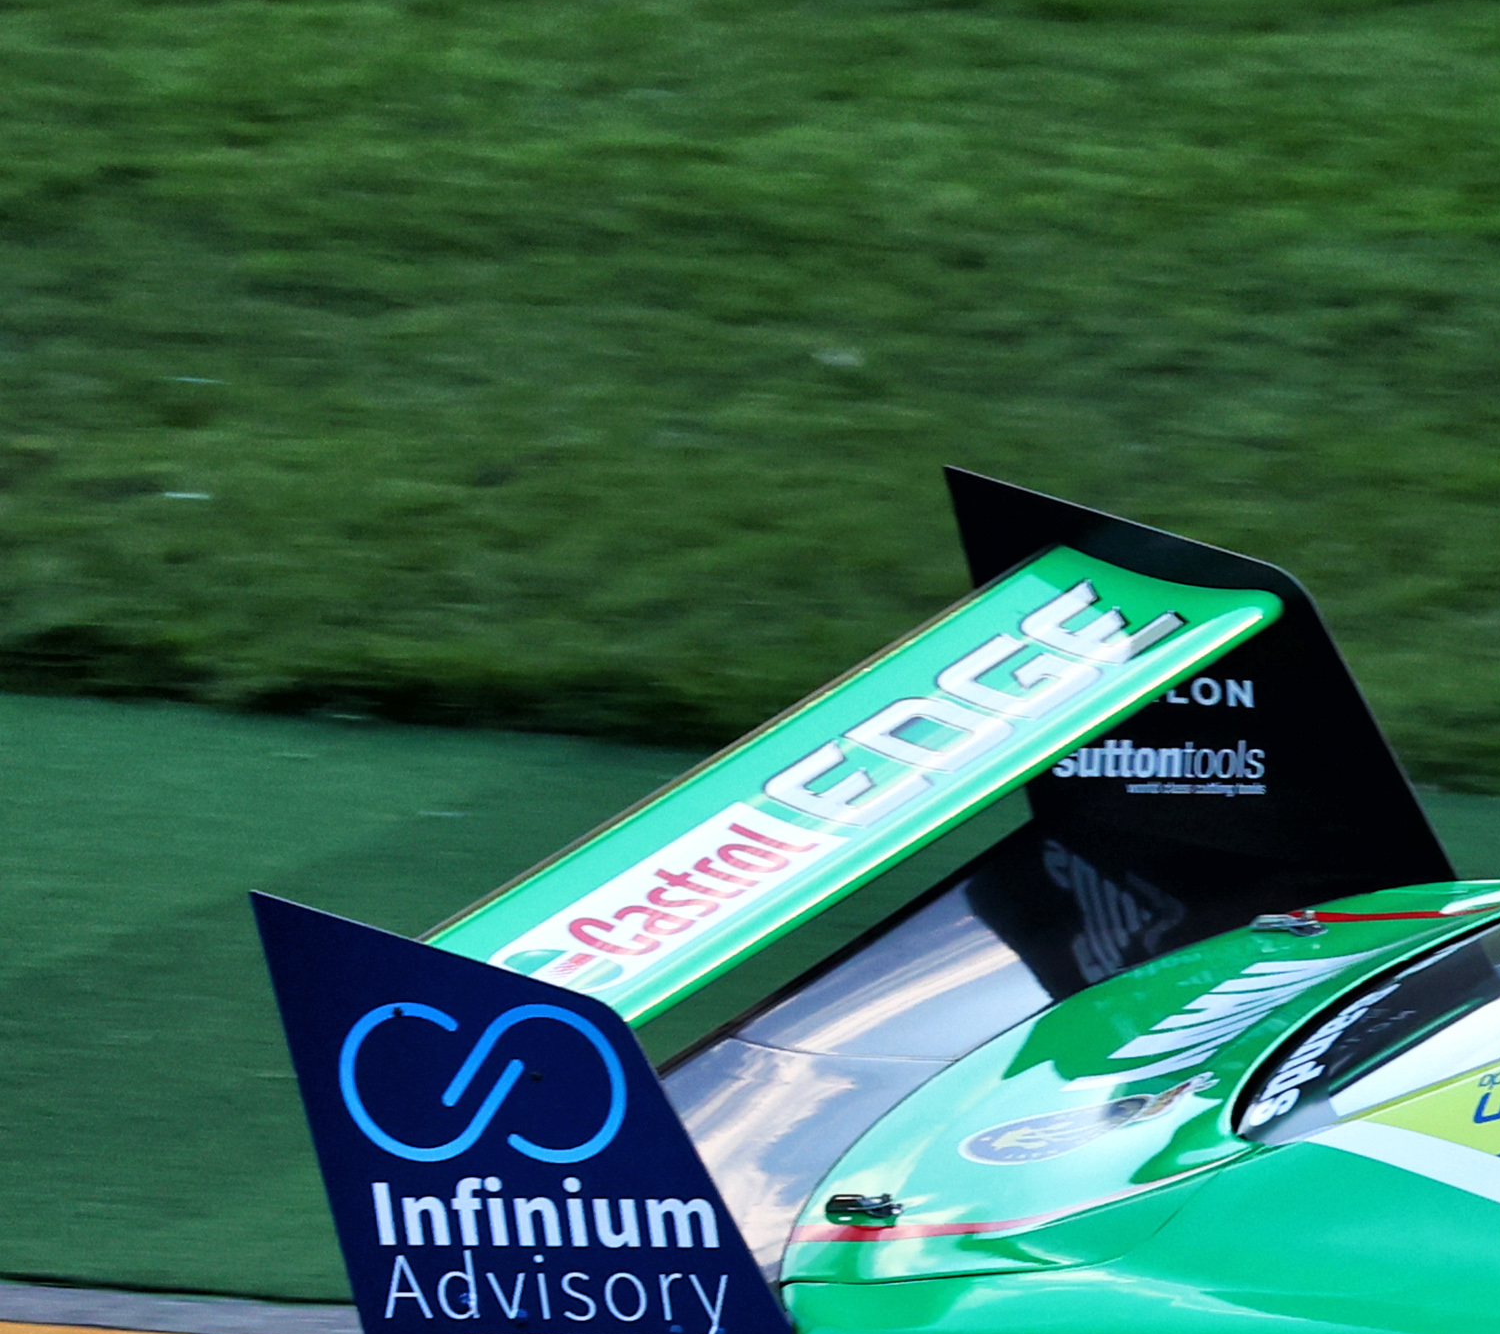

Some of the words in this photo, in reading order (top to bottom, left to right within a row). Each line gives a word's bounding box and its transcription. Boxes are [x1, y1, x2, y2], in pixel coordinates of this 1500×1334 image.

[567, 821, 823, 957] Castrol
[764, 578, 1186, 829] EDGE
[372, 1176, 719, 1247] Infinium
